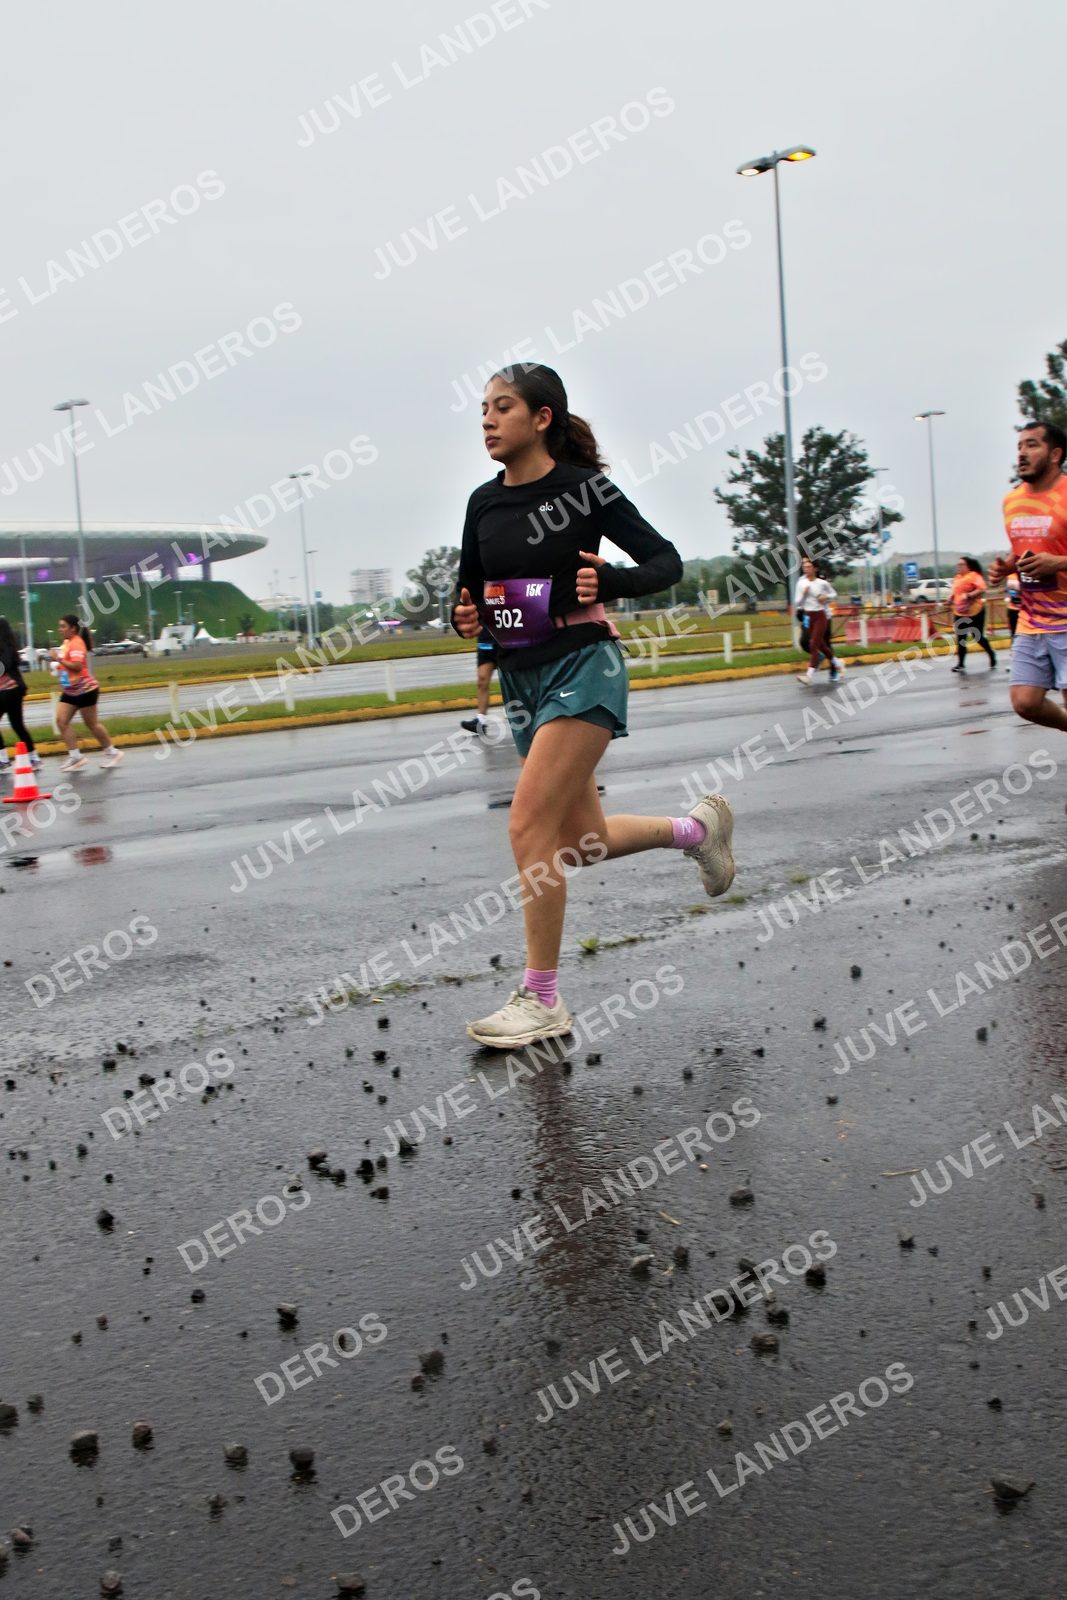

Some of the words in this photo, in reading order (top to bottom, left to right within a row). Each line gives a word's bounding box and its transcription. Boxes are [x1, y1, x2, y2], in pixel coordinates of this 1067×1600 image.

[540, 501, 553, 511] alo
[525, 583, 544, 597] 15K
[494, 608, 524, 629] 502
